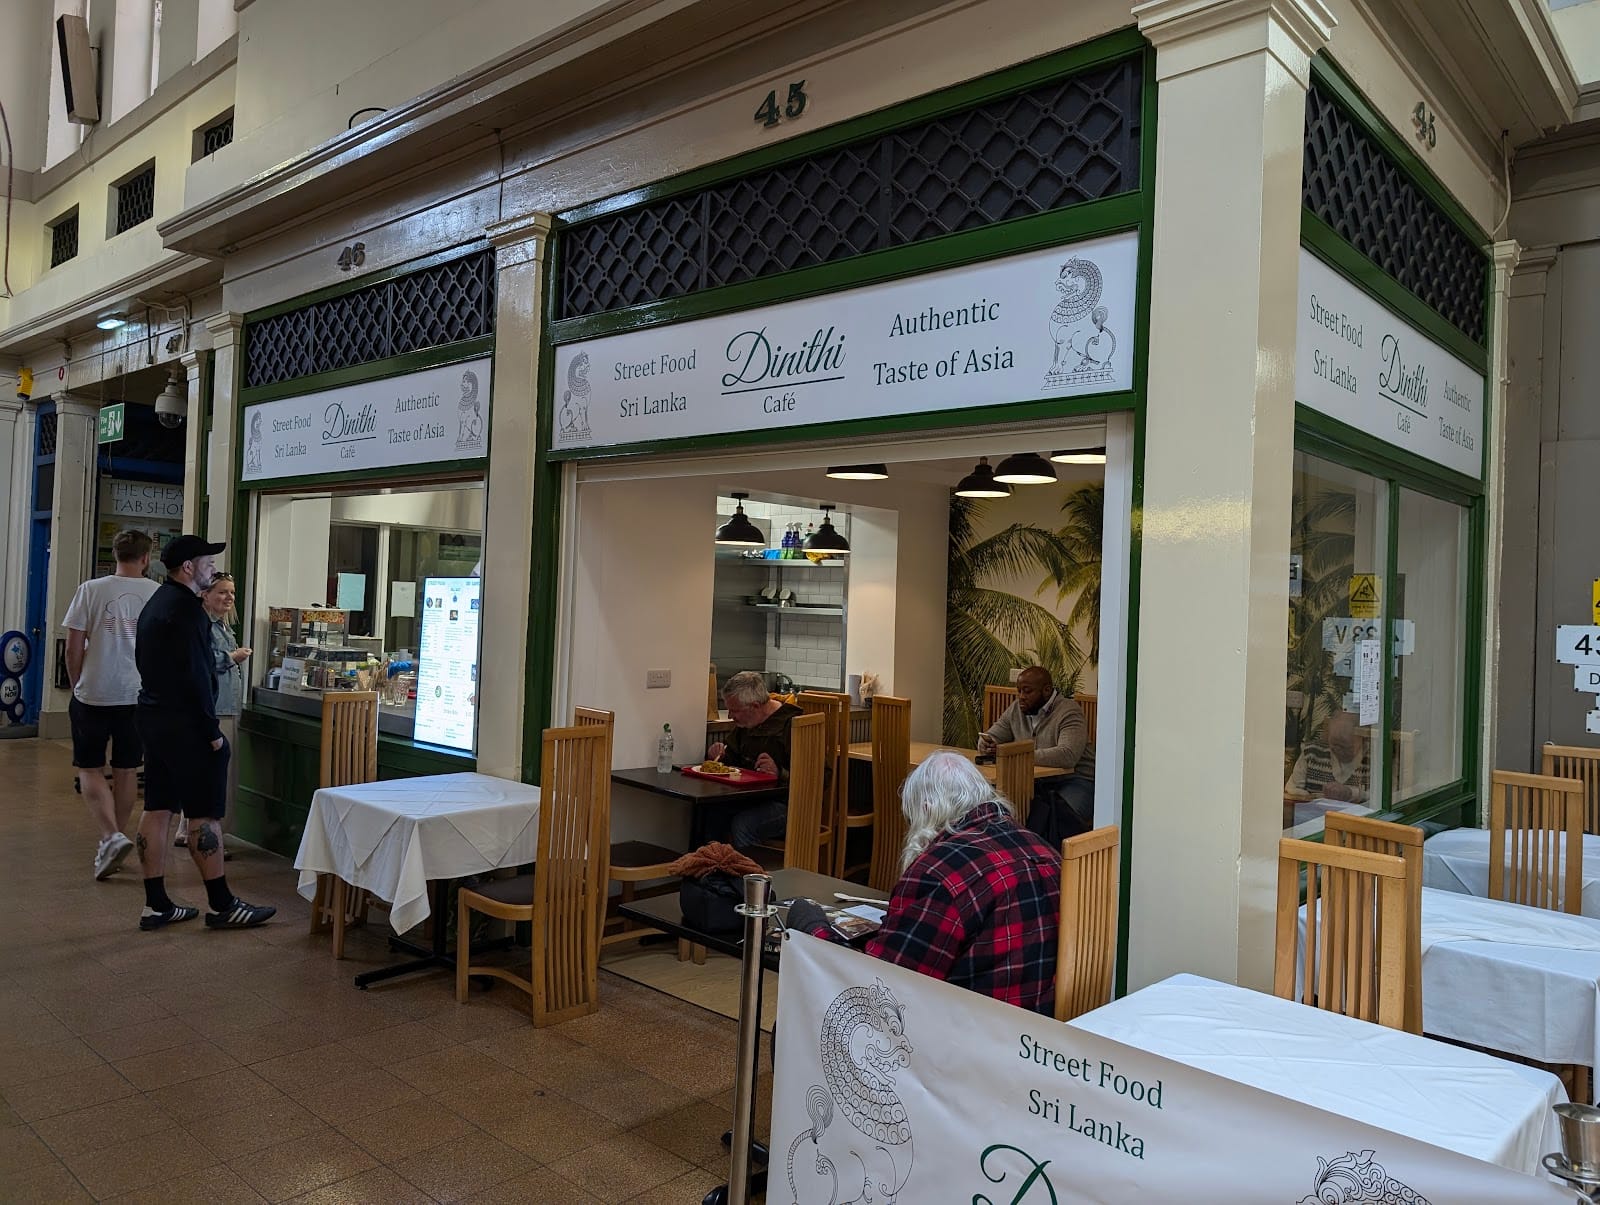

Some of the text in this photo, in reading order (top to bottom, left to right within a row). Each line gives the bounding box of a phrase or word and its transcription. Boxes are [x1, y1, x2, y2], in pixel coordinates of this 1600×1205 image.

[754, 79, 807, 128] 45
[1411, 101, 1437, 148] 45
[337, 241, 366, 271] 46
[888, 298, 1000, 338] Authentic
[1310, 294, 1363, 348] Street Food
[614, 349, 697, 381] Street Food
[721, 326, 847, 387] Dinithi
[873, 346, 1015, 386] Taste of Asia
[1313, 349, 1357, 394] Sri Lanka
[1379, 334, 1429, 407] Dinithi
[394, 391, 440, 413] Authentic
[619, 391, 687, 418] Sri Lanka
[763, 391, 796, 414] Café
[1443, 380, 1472, 413] Authentic
[272, 413, 312, 433] Street Food
[322, 400, 377, 440] Dinithi
[387, 423, 445, 445] Taste of Asia
[1397, 411, 1411, 435] Café
[1439, 416, 1474, 451] Taste of Asia
[274, 441, 307, 459] Sri Lanka
[340, 445, 356, 459] Café
[110, 482, 184, 501] THE CHEA
[112, 499, 184, 515] TAB SHO
[1019, 1034, 1163, 1109] Street Food
[1028, 1089, 1145, 1160] Sri Lanka
